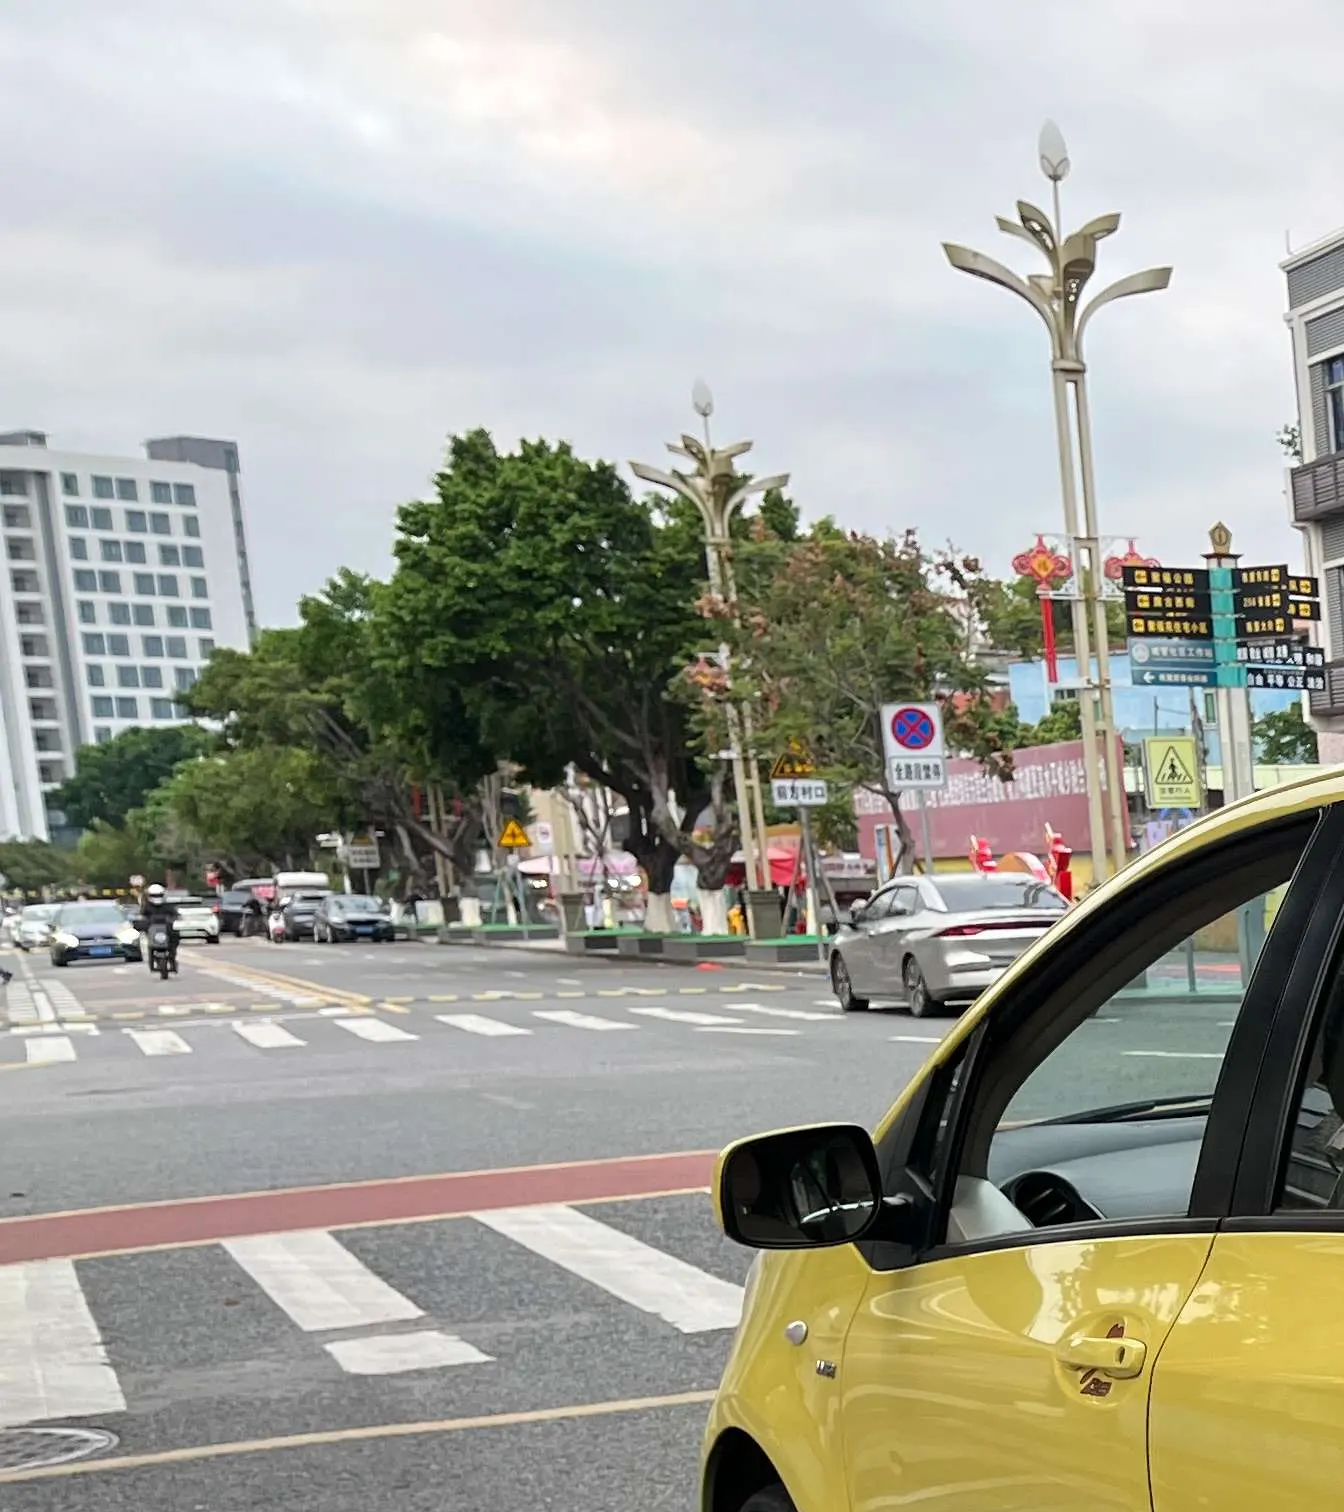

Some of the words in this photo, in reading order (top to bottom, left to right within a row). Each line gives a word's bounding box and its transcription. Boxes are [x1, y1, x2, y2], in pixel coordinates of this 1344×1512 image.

[895, 762, 940, 780] 全路段禁停
[777, 785, 825, 800] 前方村口
